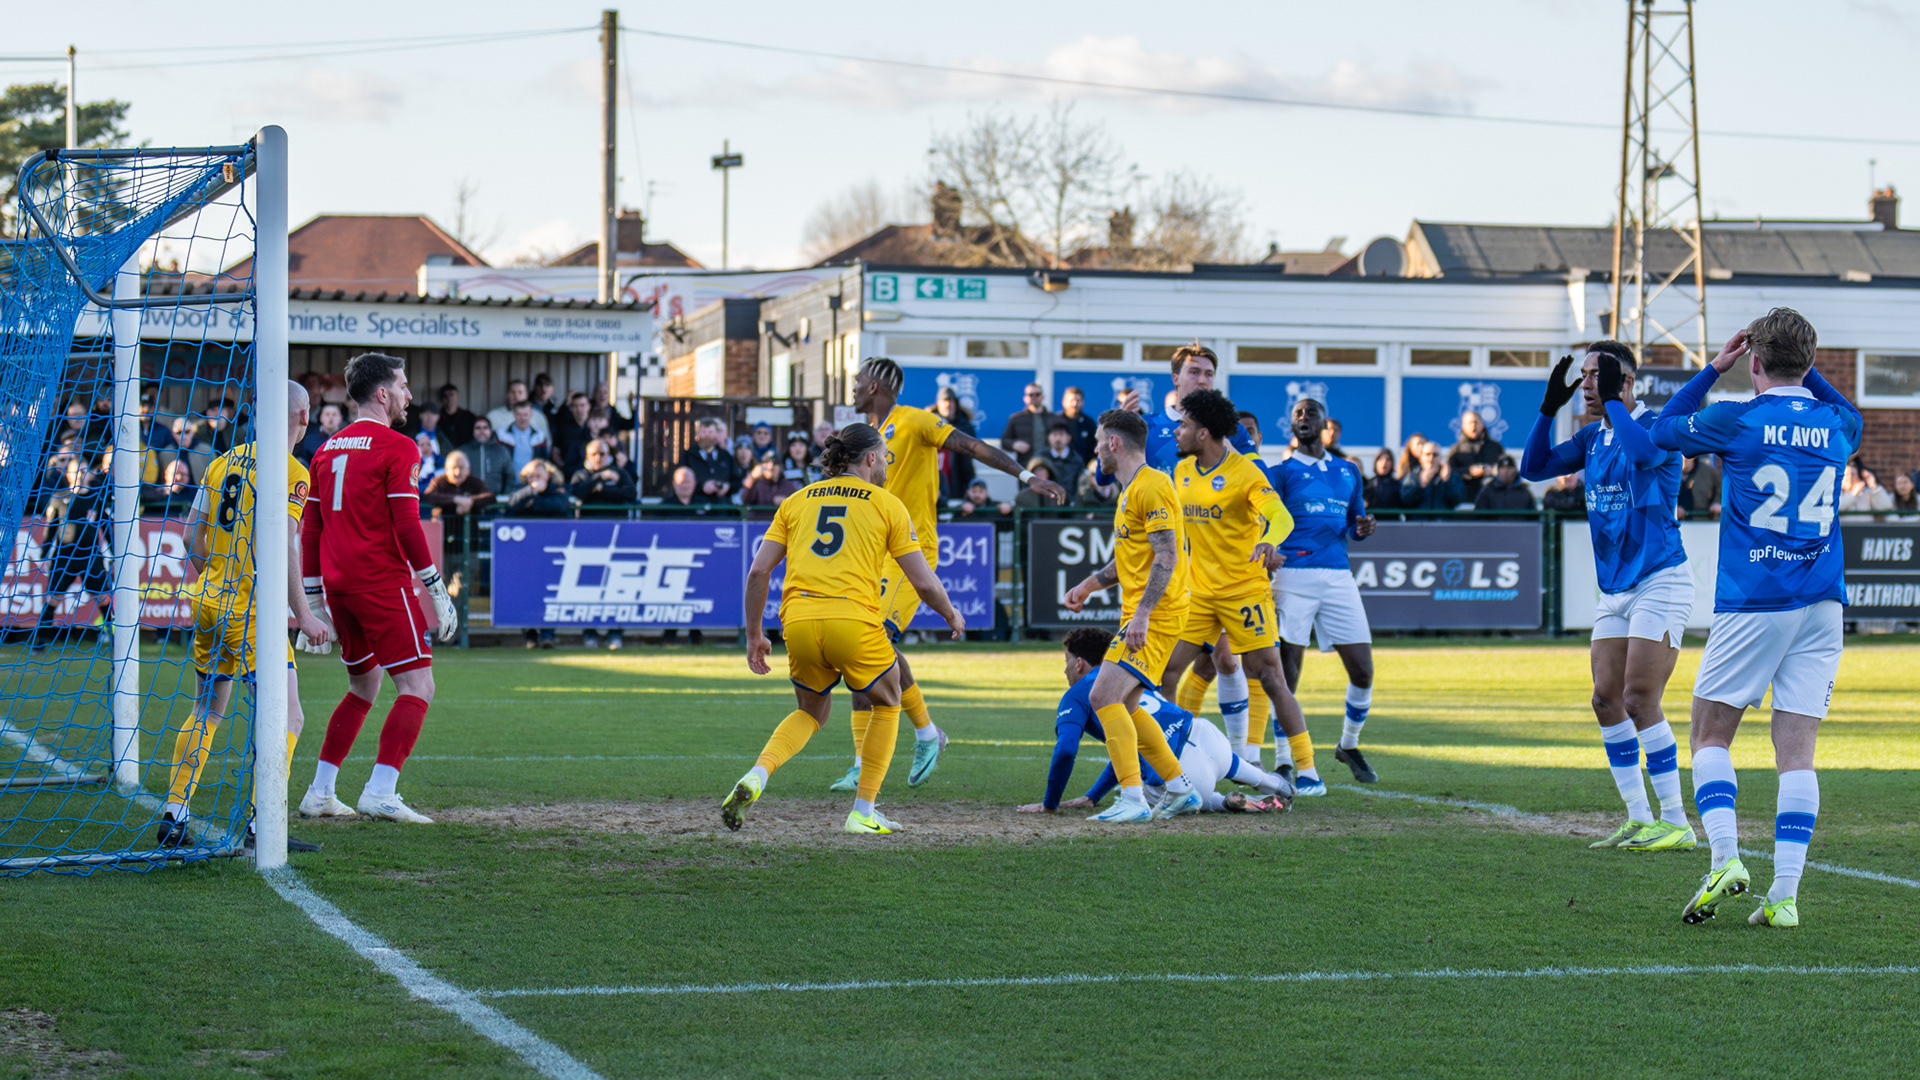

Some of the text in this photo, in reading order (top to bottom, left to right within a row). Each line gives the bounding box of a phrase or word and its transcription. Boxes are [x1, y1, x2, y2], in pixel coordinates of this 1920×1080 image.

[288, 308, 358, 333] minate
[366, 311, 481, 338] Specialists
[1763, 425, 1830, 448] MC AVOY
[331, 453, 349, 511] 1
[806, 486, 873, 501] FERNANDEZ
[217, 472, 243, 533] 8
[1749, 464, 1837, 537] 24
[810, 505, 848, 558] 5
[1861, 537, 1913, 561] HAYES
[1432, 589, 1520, 601] BARBERSHOP
[543, 603, 694, 623] SCAFFOLDING
[1239, 603, 1266, 629] 21
